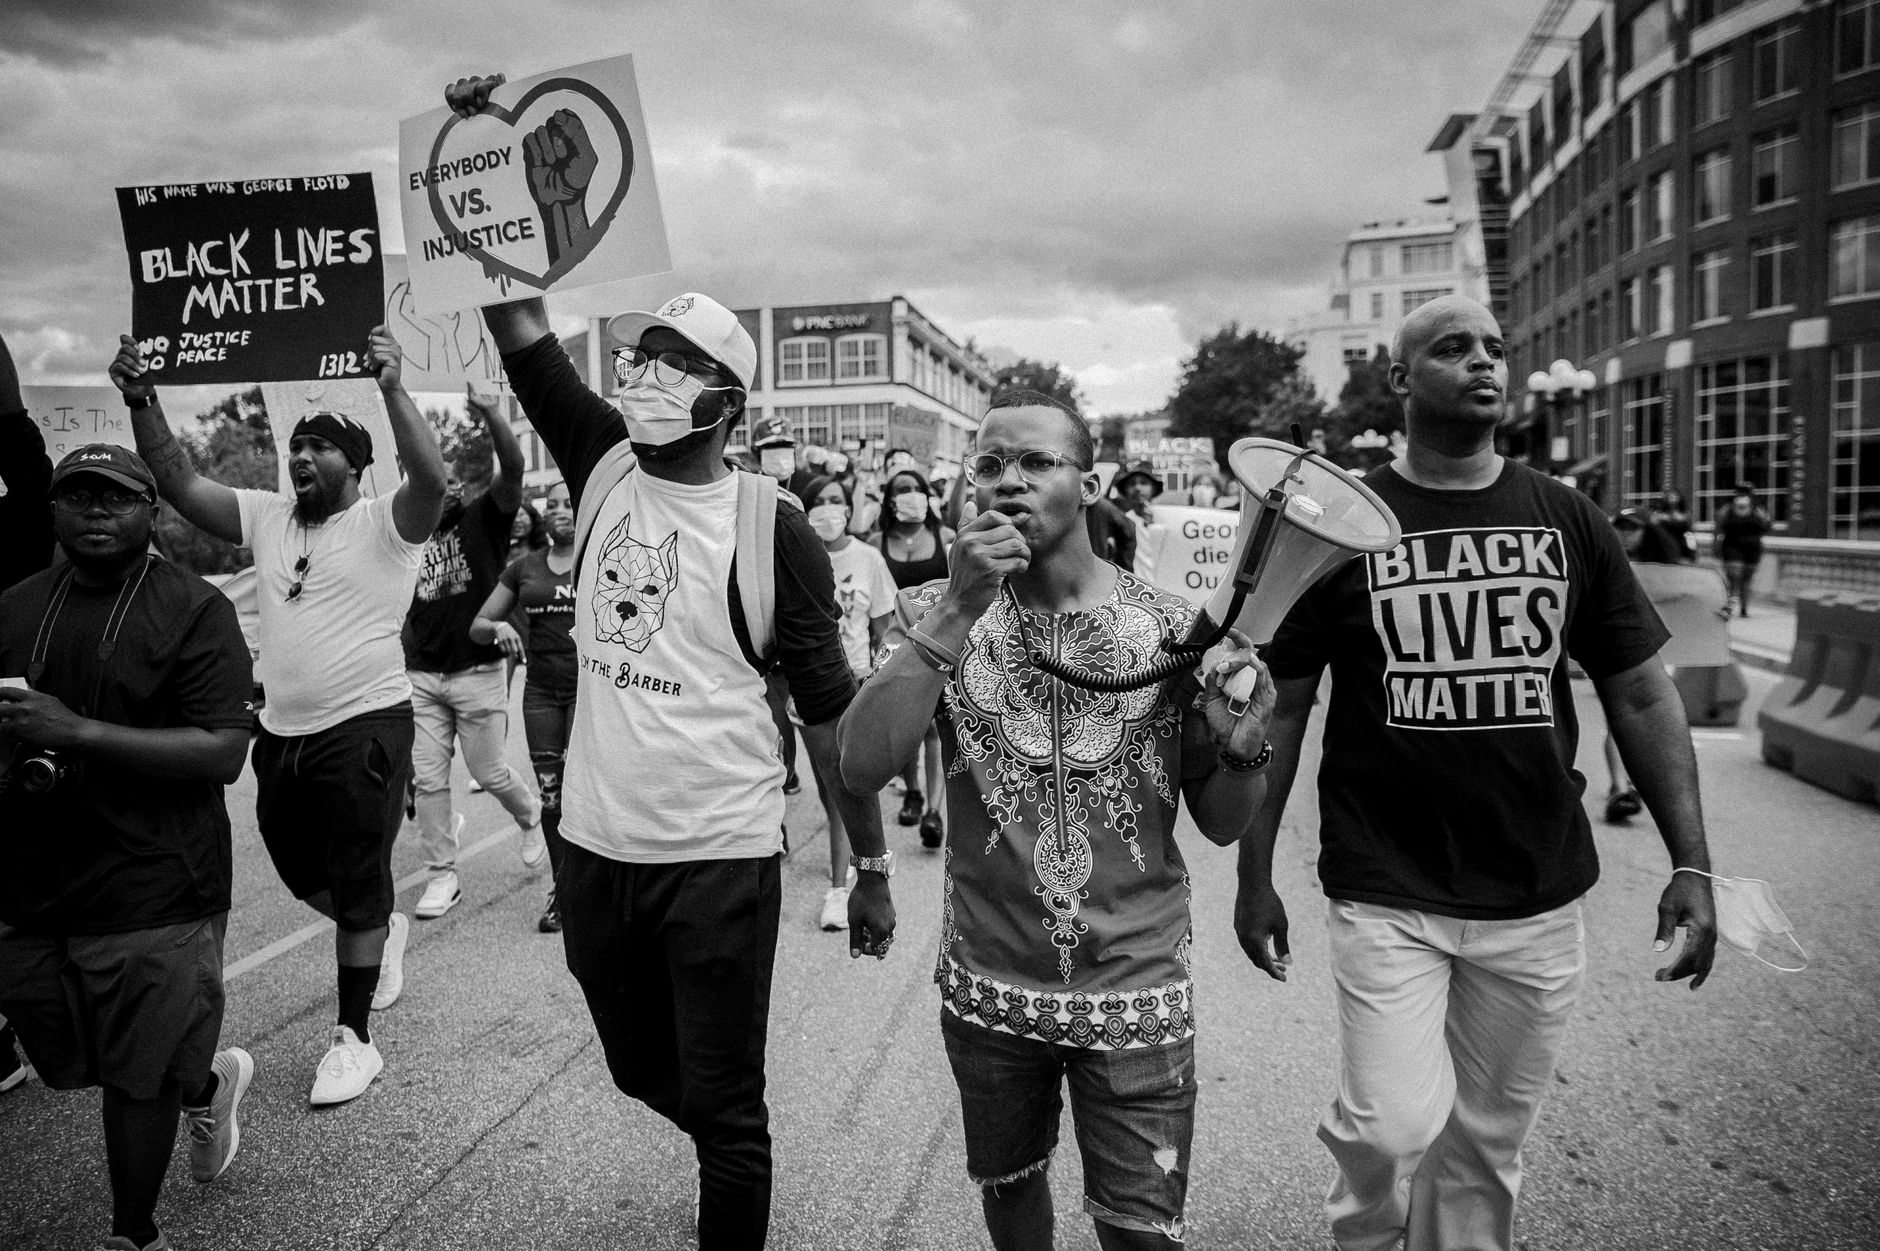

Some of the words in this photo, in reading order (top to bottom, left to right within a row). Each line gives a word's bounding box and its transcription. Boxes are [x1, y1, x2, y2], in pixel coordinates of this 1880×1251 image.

[409, 146, 512, 191] EVERYBODY
[135, 187, 158, 206] HIS
[164, 184, 198, 199] NAME
[205, 181, 236, 195] WAS
[243, 178, 293, 195] GEORGE
[303, 175, 350, 191] FLOYD
[449, 188, 492, 219] VS.
[140, 227, 251, 284] BLACK
[274, 227, 376, 269] LIVES
[422, 217, 536, 262] INJUSTICE
[181, 273, 325, 325] MATTER
[138, 336, 170, 357] NO
[179, 330, 252, 349] JUSTICE
[176, 347, 228, 368] PEACE
[318, 351, 361, 378] 1312
[53, 407, 80, 432] Is
[86, 408, 123, 433] The
[1374, 532, 1561, 587] BLACK
[1380, 586, 1560, 664] LIVES
[591, 659, 612, 679] THE
[614, 662, 682, 697] BARBER
[1390, 671, 1552, 720] MATTER
